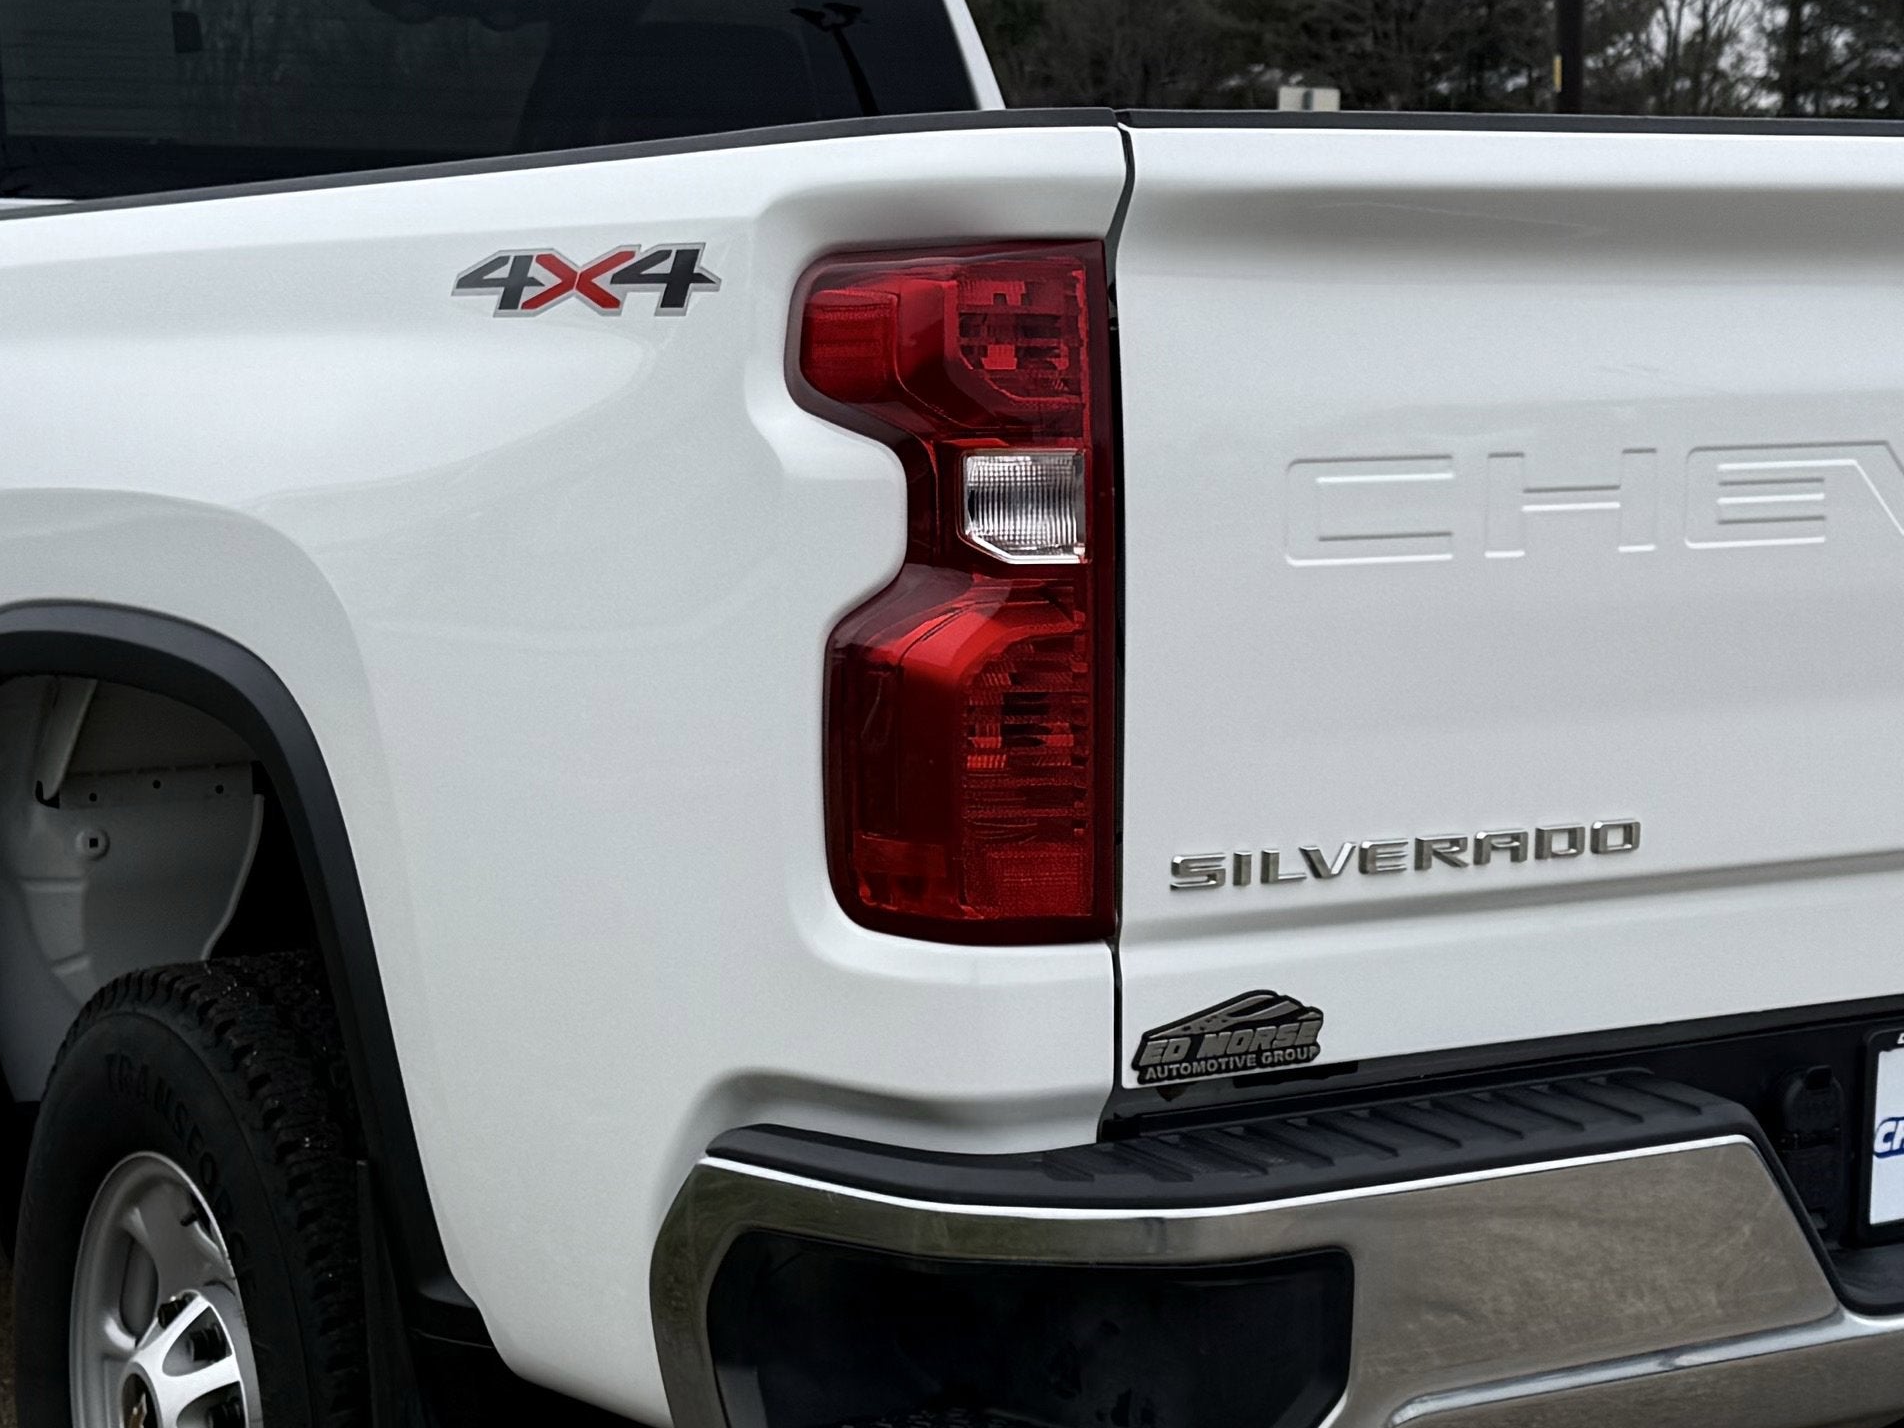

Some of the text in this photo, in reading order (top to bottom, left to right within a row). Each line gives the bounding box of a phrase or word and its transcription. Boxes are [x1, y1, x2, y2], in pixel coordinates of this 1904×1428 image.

[1169, 817, 1642, 891] SILVERADO
[1138, 1019, 1323, 1068] ED MORSE
[1145, 1044, 1321, 1081] AUTOMOTIVE GROUP
